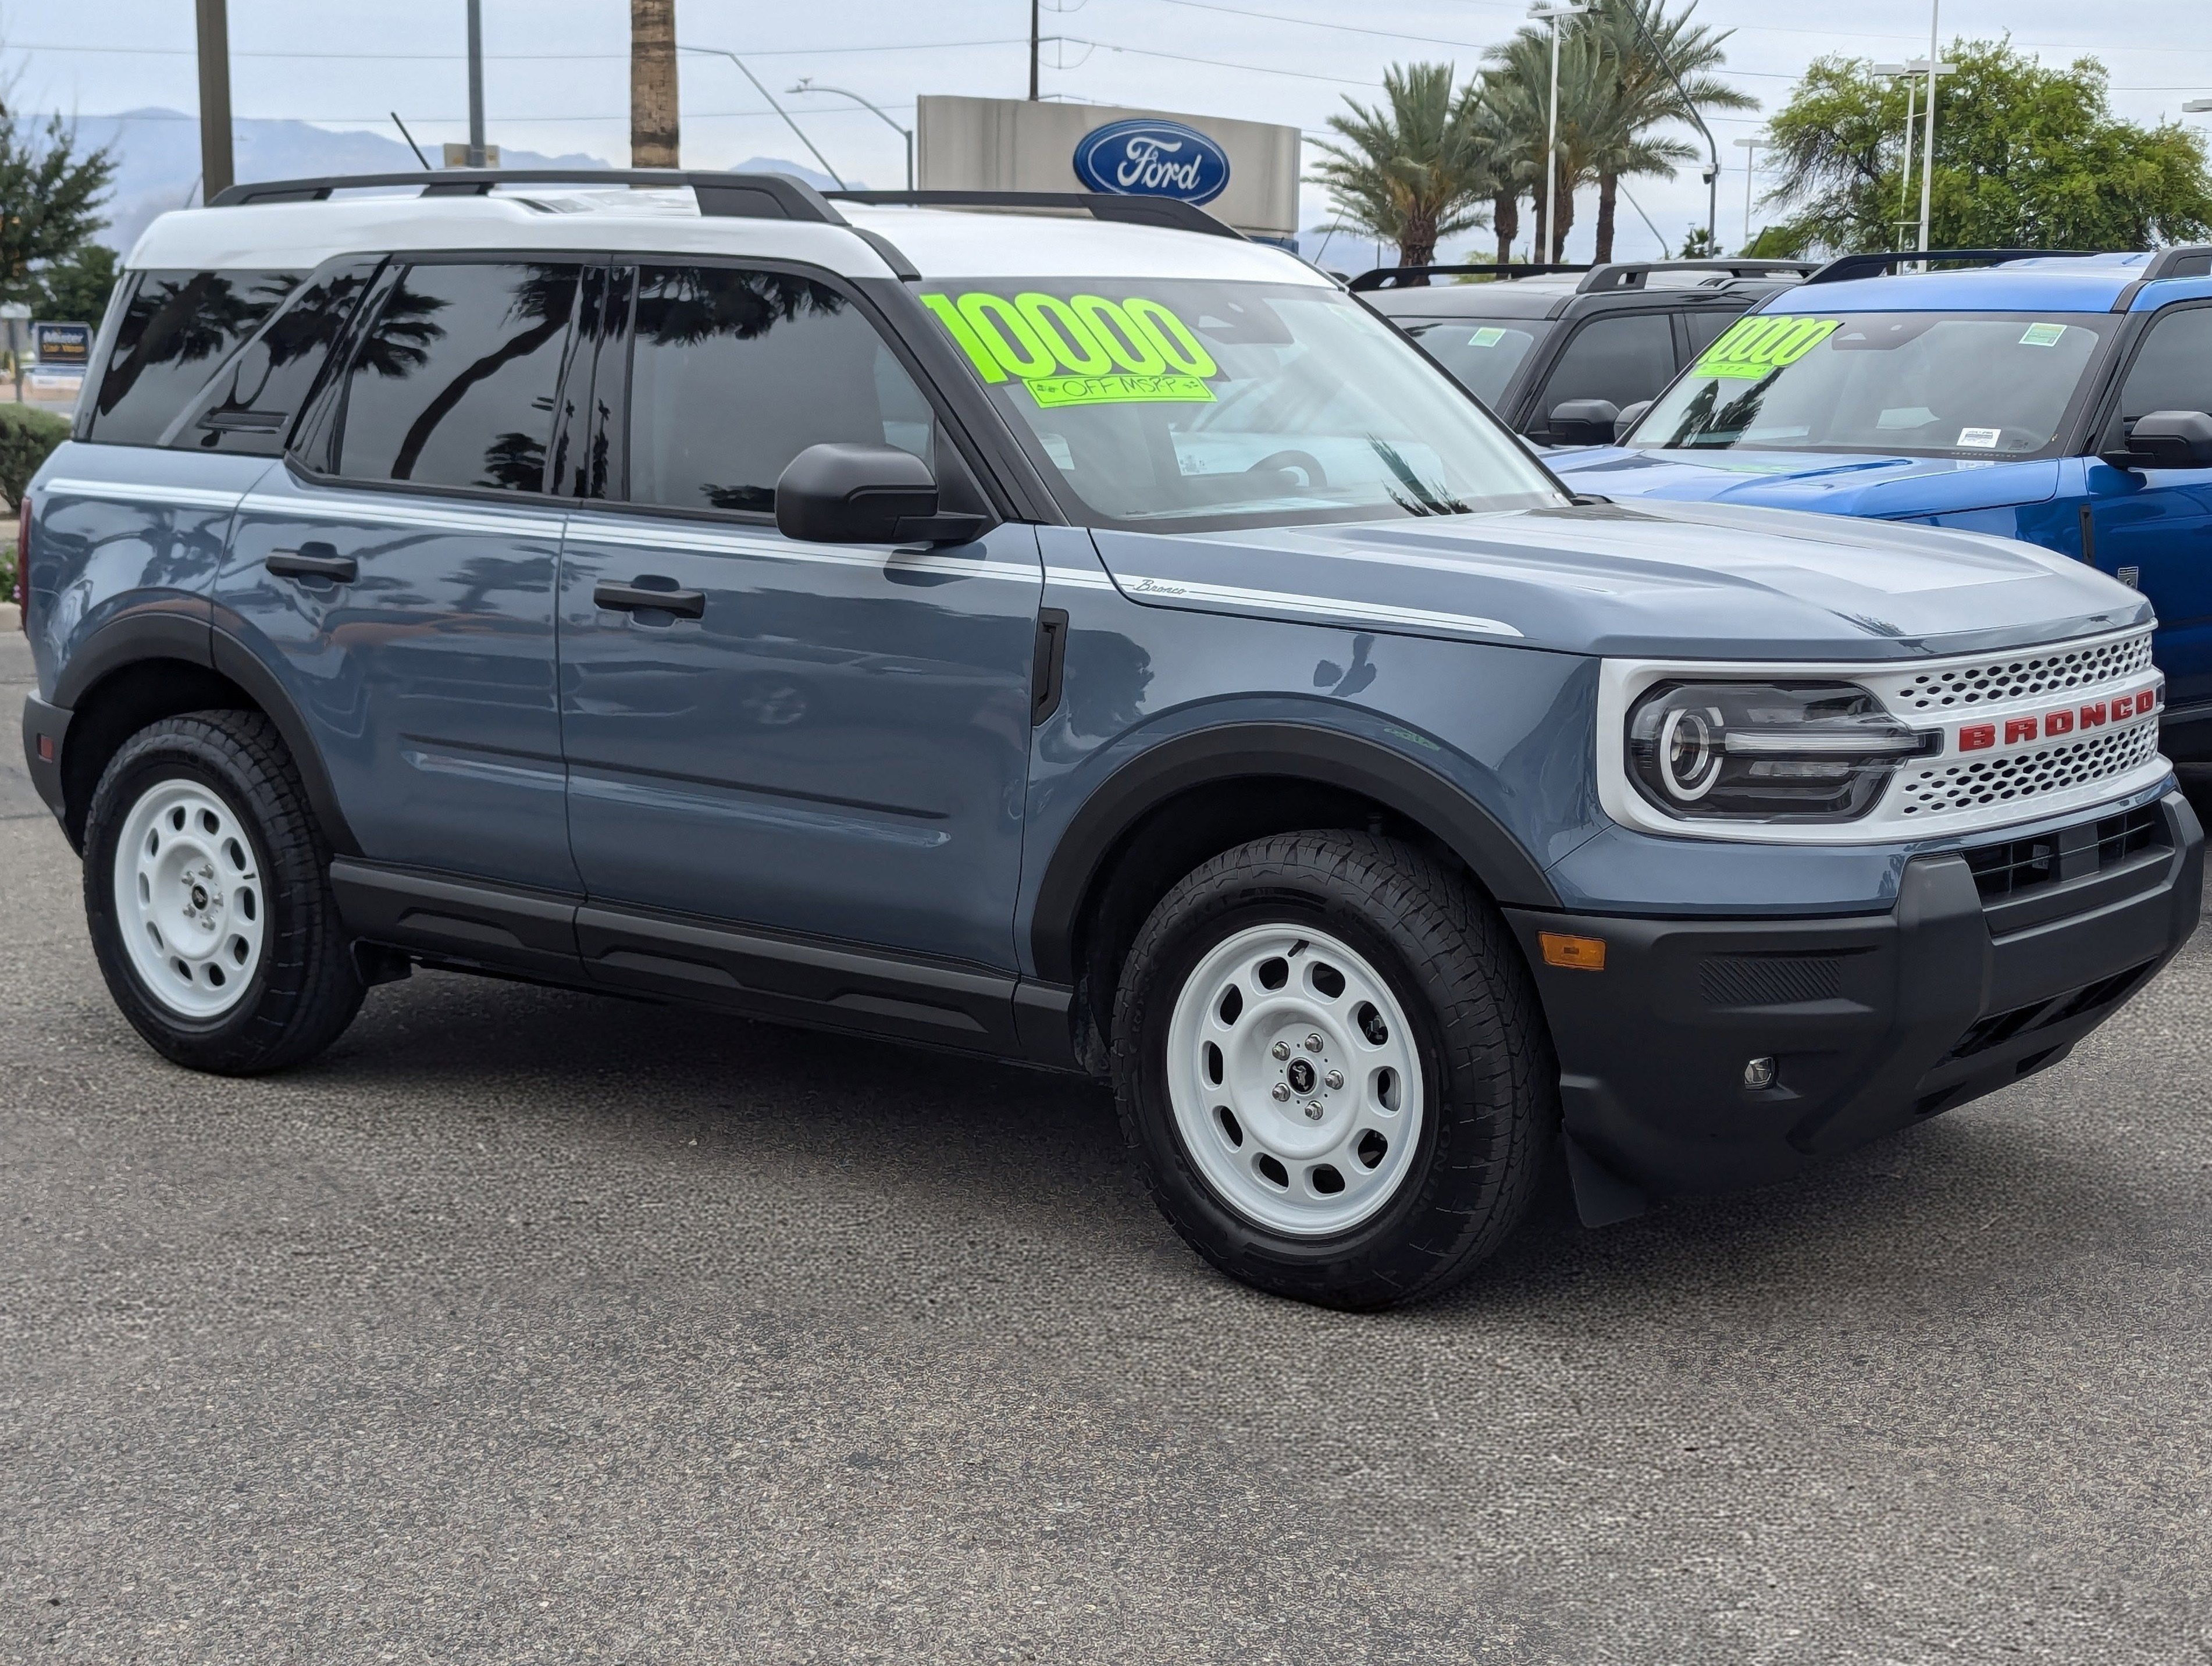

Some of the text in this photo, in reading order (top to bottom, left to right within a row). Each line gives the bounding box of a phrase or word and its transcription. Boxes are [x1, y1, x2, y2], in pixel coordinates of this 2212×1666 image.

[1117, 137, 1202, 190] Ford
[920, 293, 1217, 383] 10000
[1696, 316, 1839, 366] 10000
[1063, 378, 1114, 397] OFF
[1133, 579, 1187, 595] Bronco
[1959, 689, 2154, 752] BRONCO
